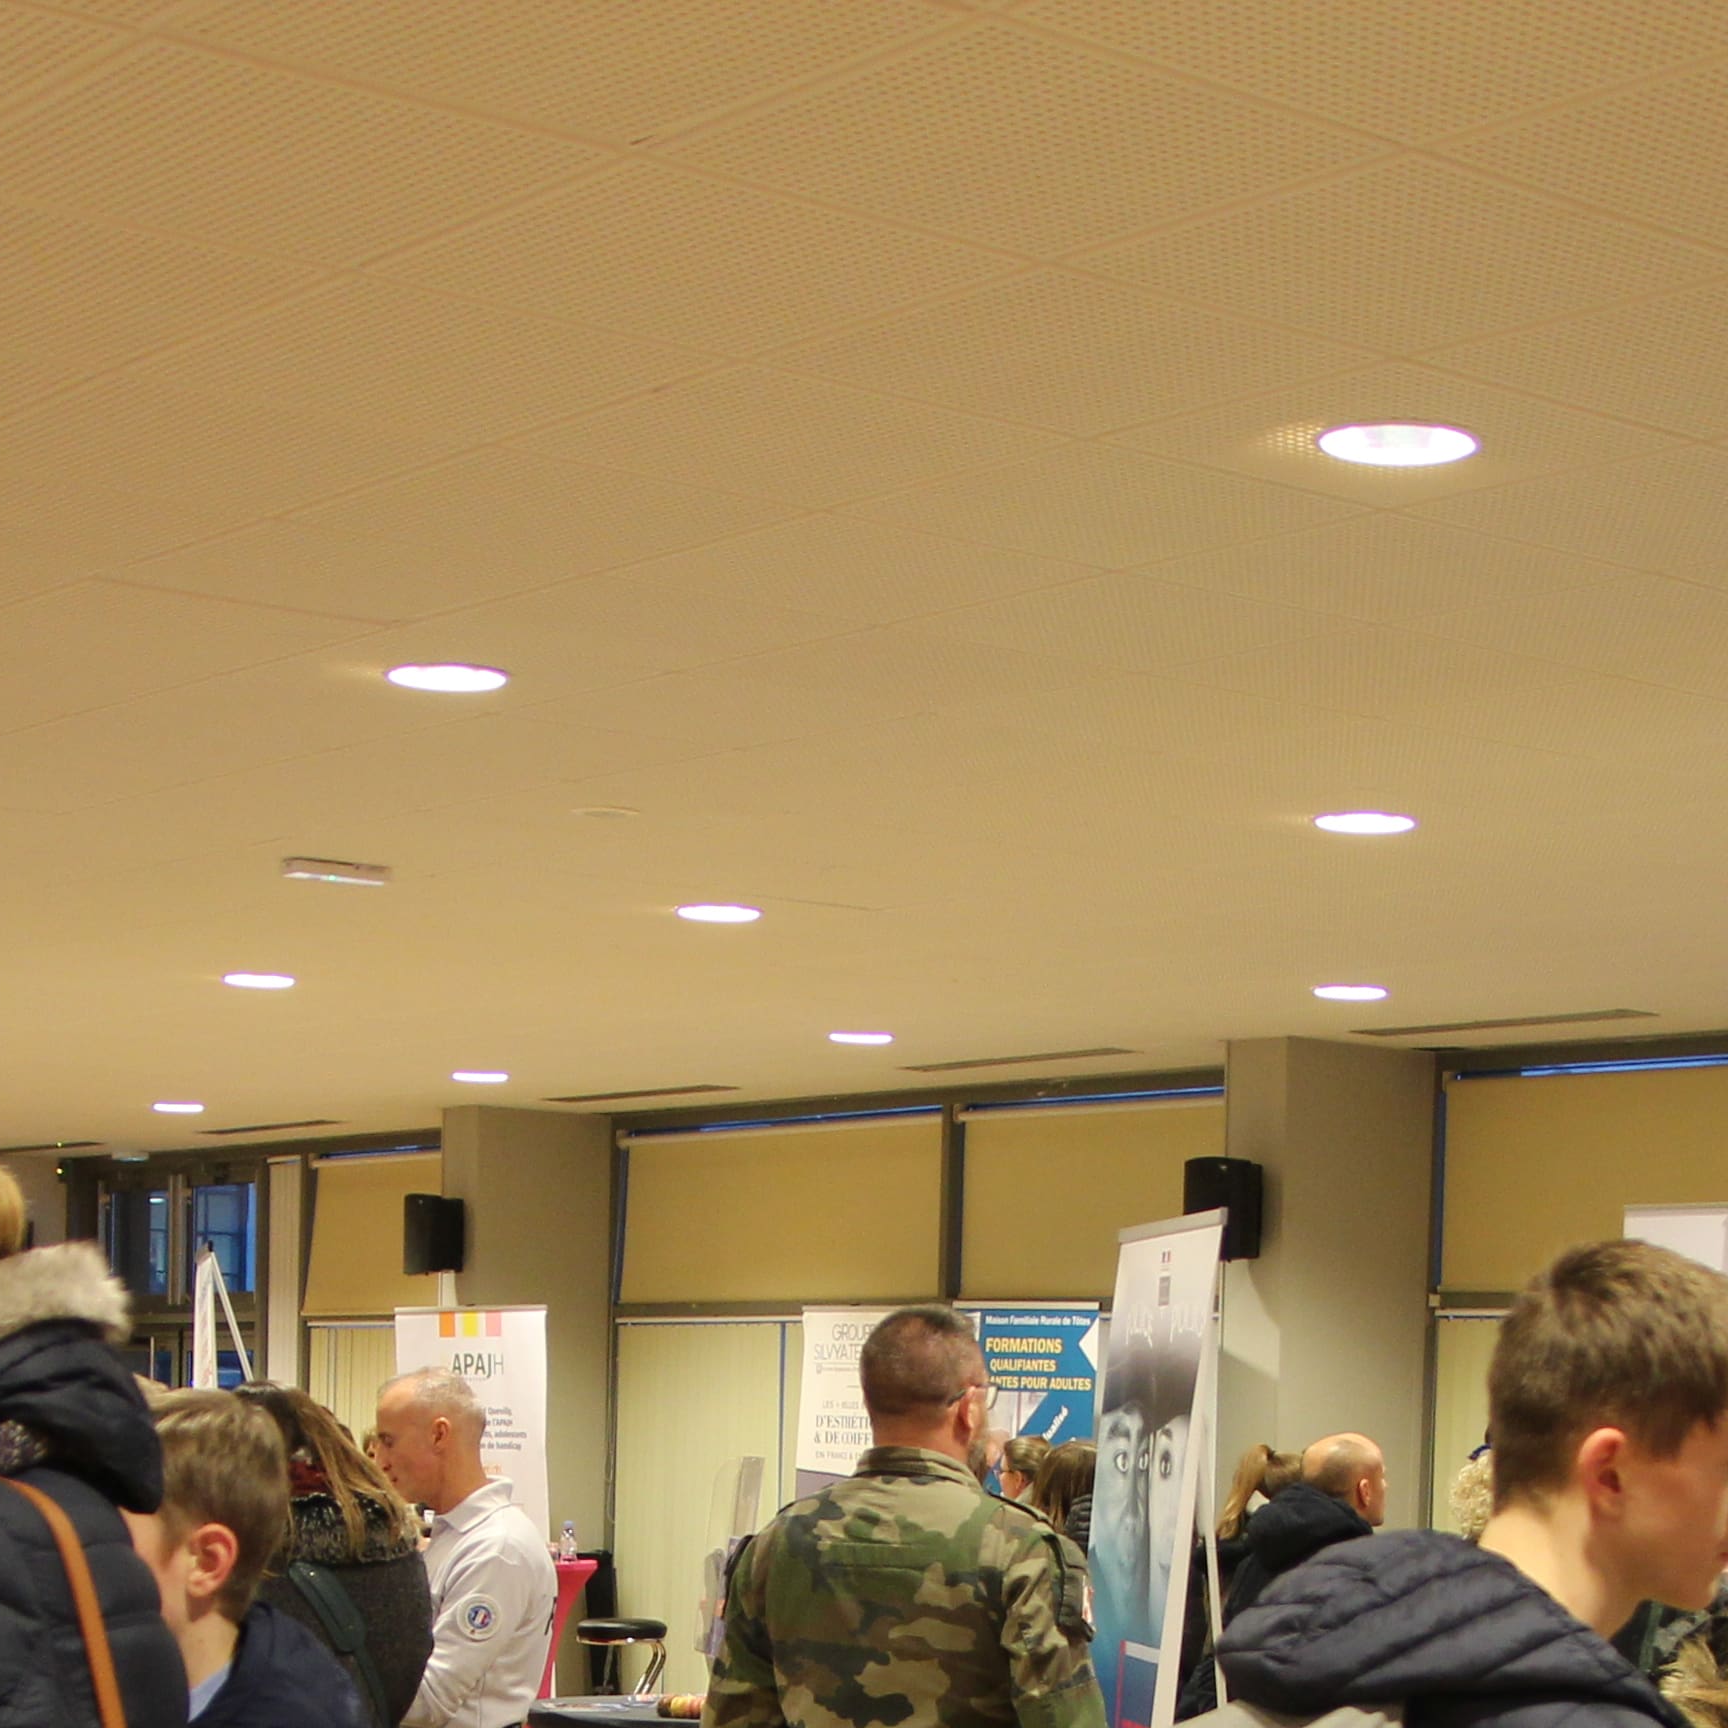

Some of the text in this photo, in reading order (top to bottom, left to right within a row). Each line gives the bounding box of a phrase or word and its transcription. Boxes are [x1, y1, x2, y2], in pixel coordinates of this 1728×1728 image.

[985, 1337, 1063, 1353] FORMATIONS
[452, 1353, 504, 1378] APAJH
[990, 1358, 1057, 1372] QUALIFIANTES
[991, 1375, 1092, 1391] ANTES POUR ADULTES
[815, 1412, 870, 1429] D'ESTHÉTI
[841, 1432, 872, 1445] COIFF
